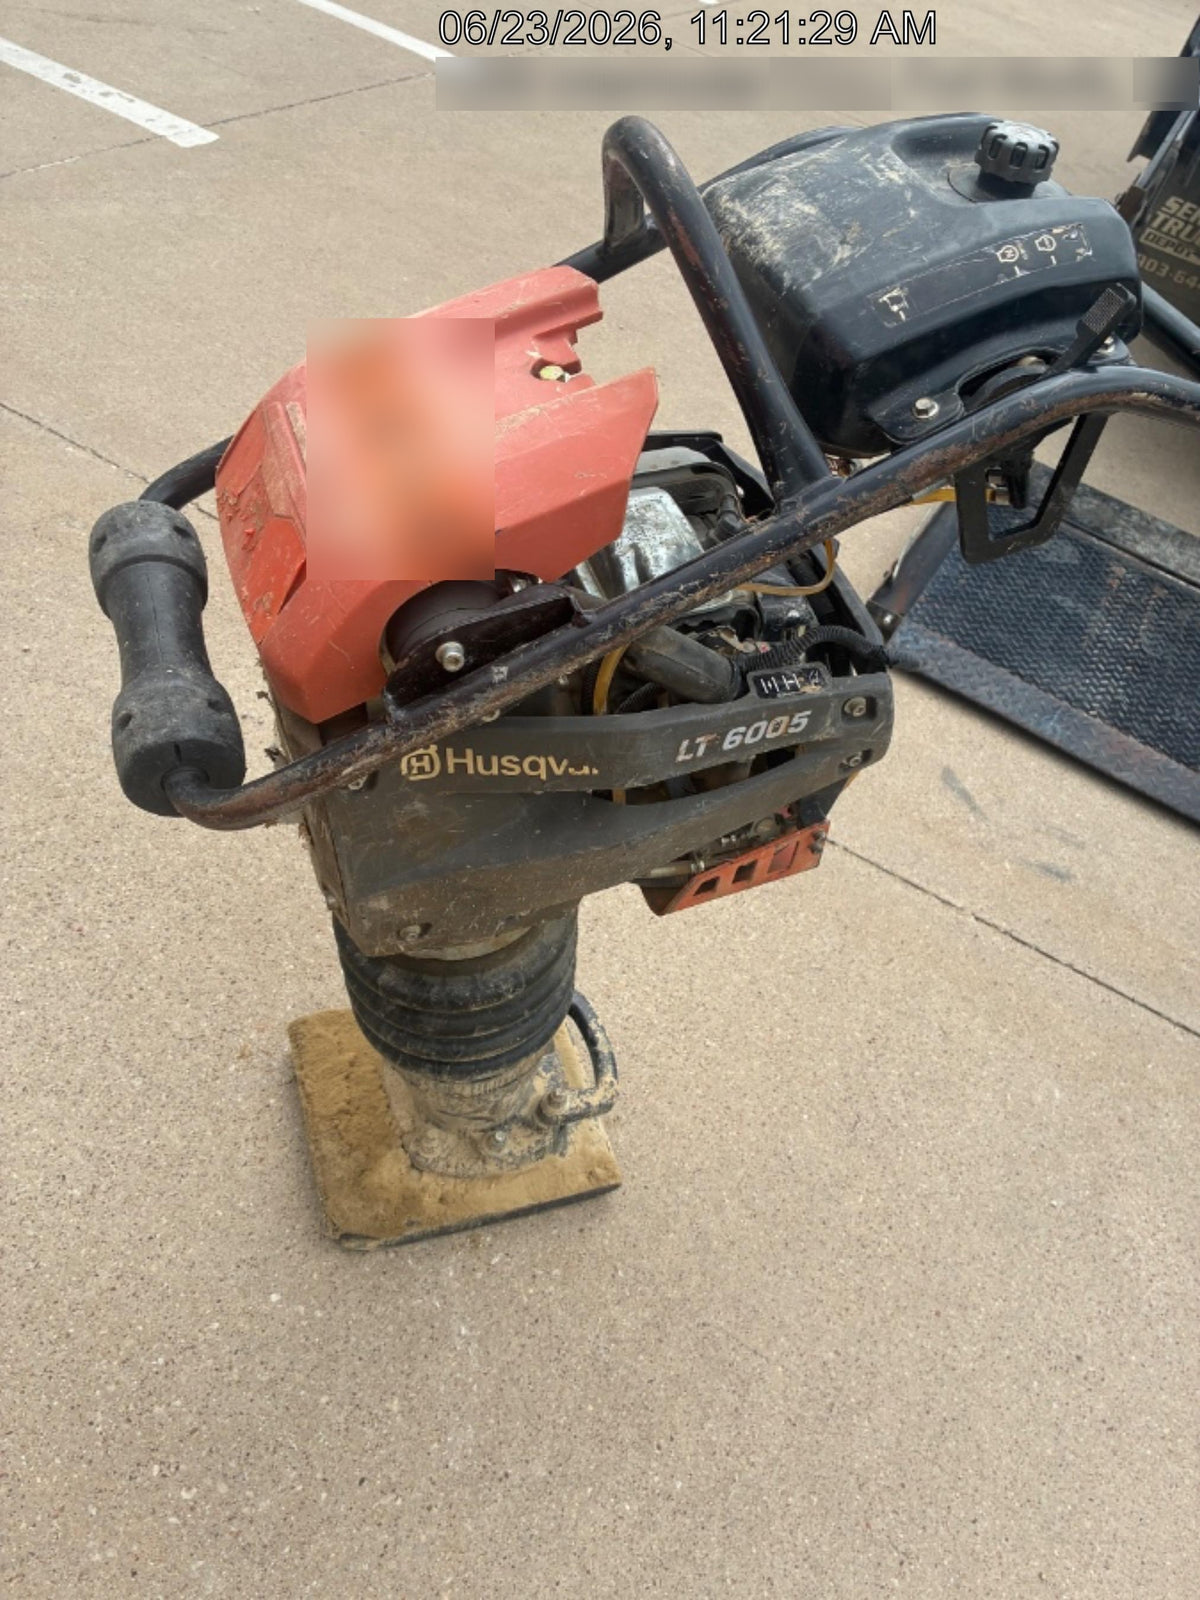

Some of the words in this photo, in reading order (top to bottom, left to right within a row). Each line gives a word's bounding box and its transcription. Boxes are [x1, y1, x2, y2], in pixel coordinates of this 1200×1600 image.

[675, 733, 719, 763] LT
[722, 710, 812, 751] 6005
[445, 747, 599, 781] Husqv
